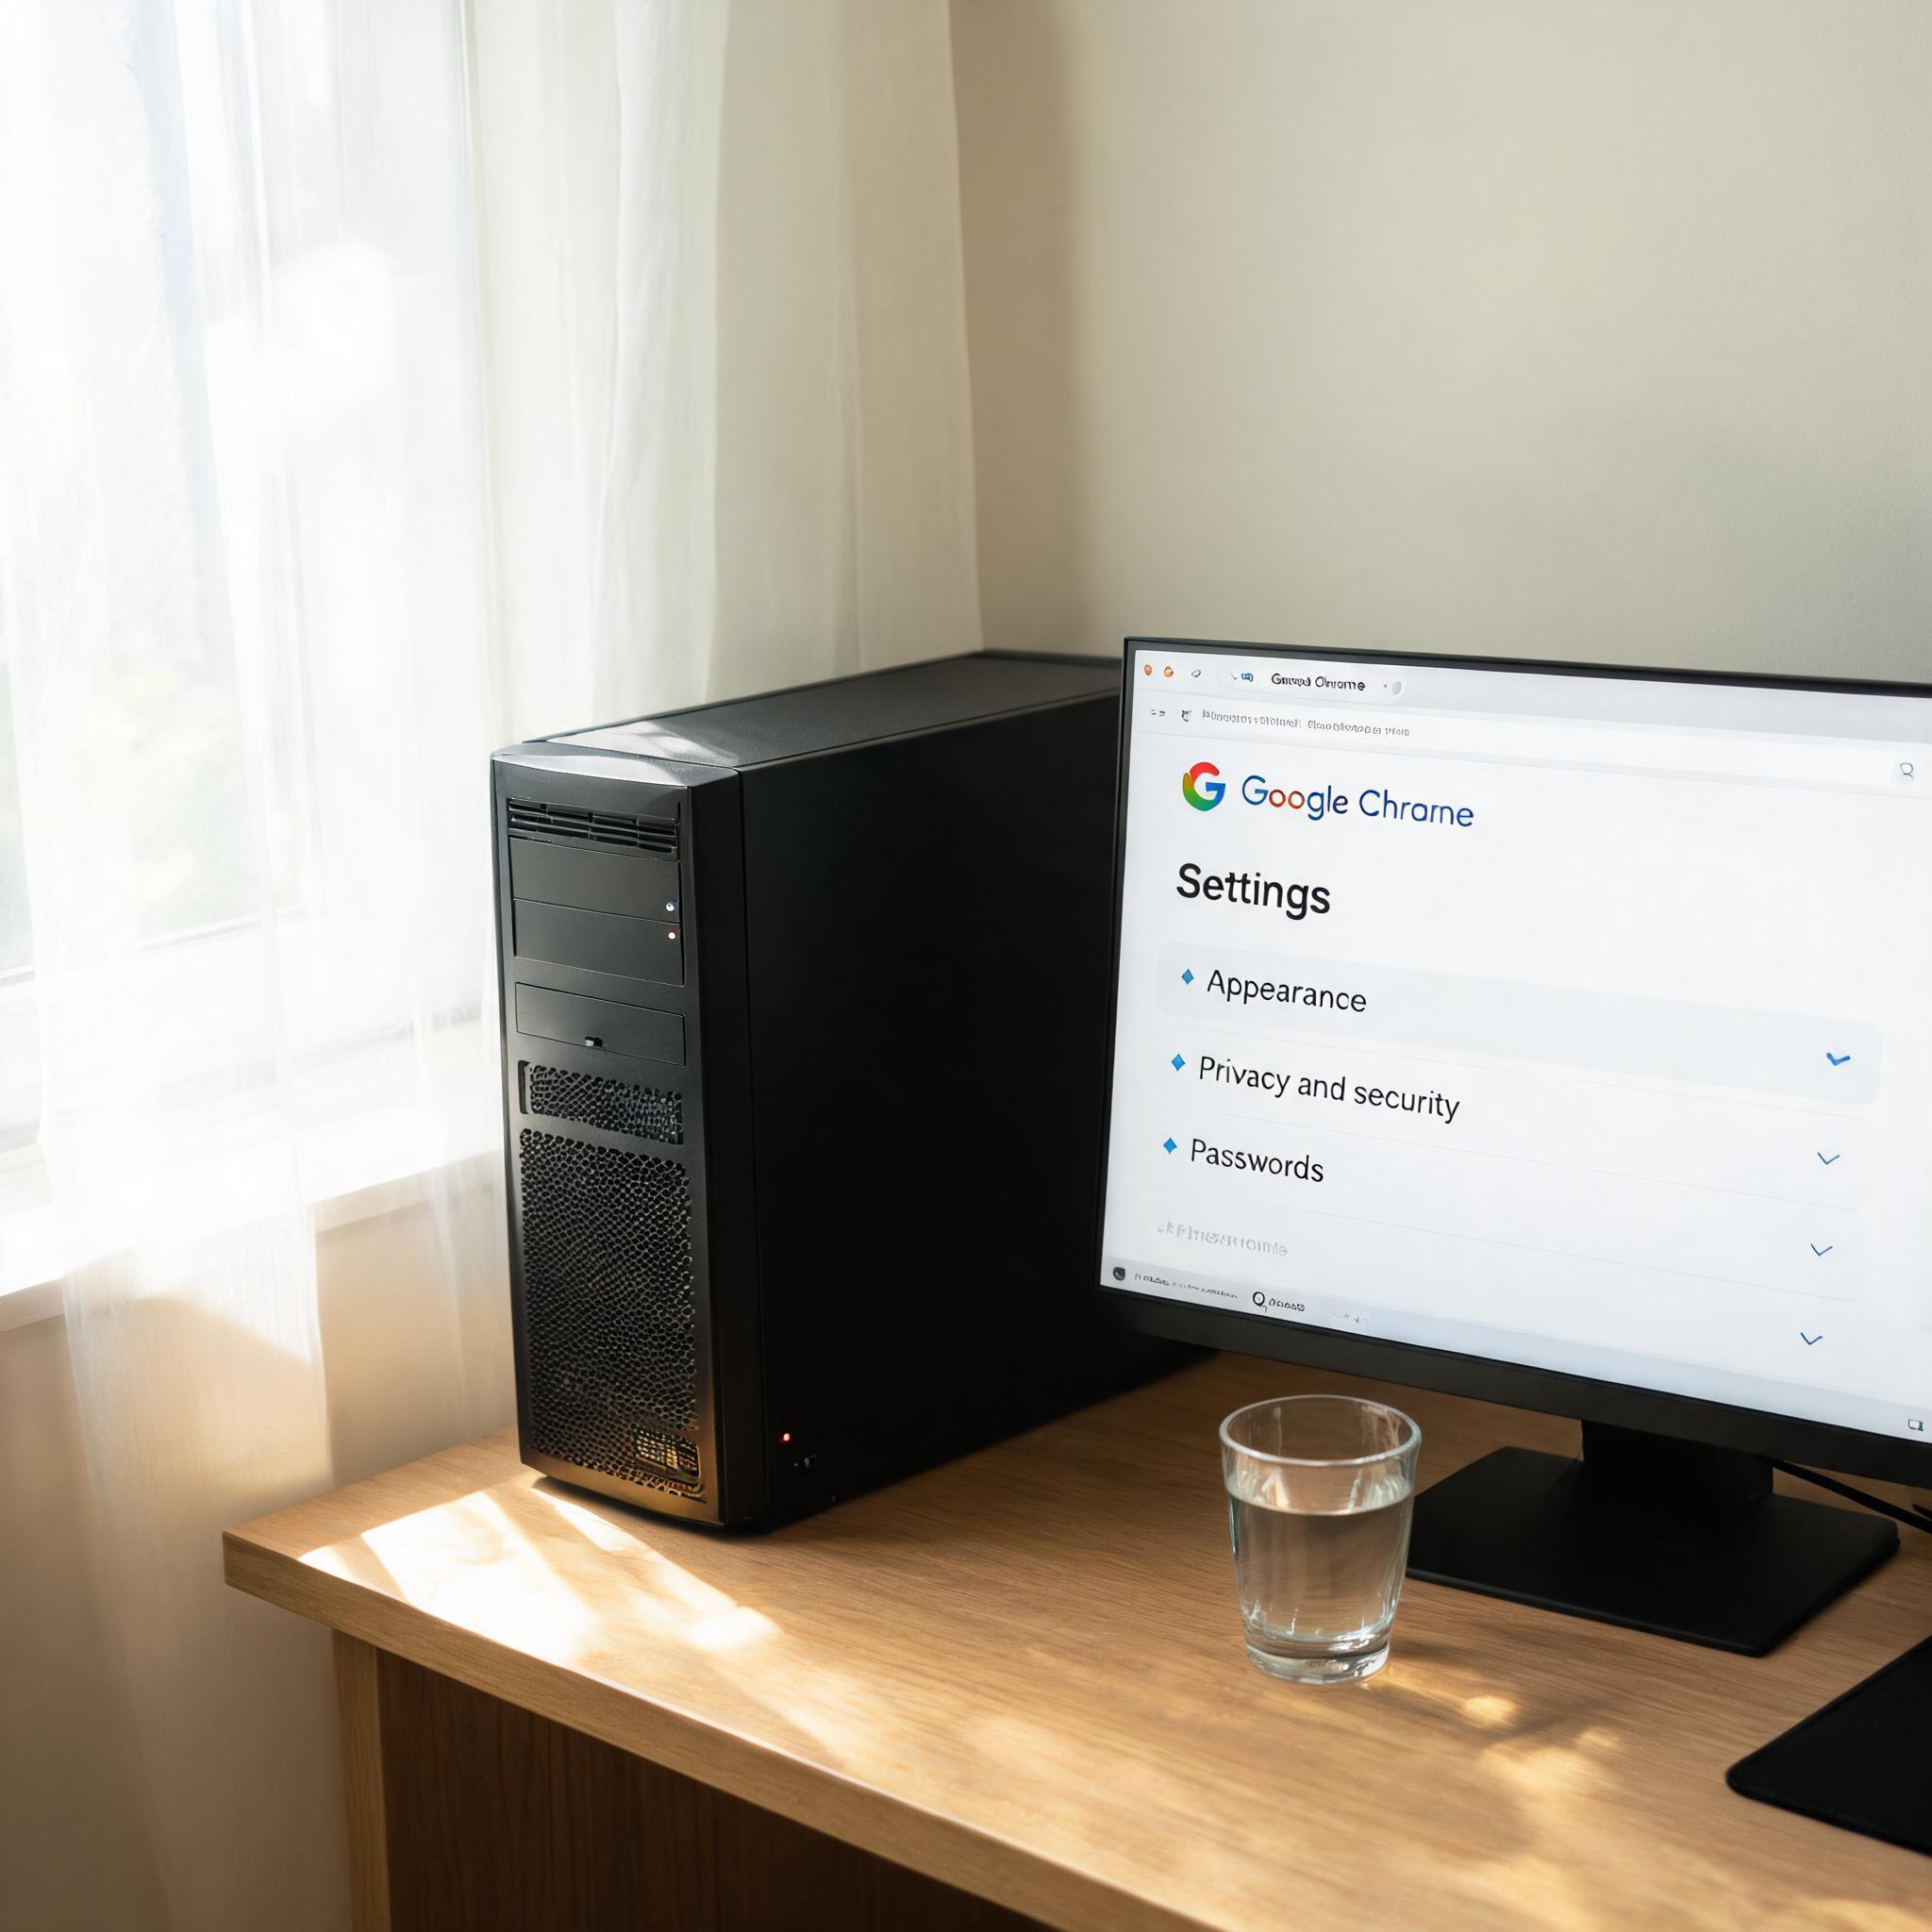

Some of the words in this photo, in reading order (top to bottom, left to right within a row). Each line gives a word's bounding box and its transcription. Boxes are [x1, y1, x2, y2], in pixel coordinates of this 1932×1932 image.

[1241, 774, 1349, 821] Google
[1176, 862, 1331, 921] Settings
[1207, 969, 1367, 1012] Appearance
[1199, 1056, 1291, 1098] Privacy
[1297, 1075, 1346, 1102] and
[1354, 1086, 1460, 1124] security
[1191, 1138, 1324, 1183] Passwords
